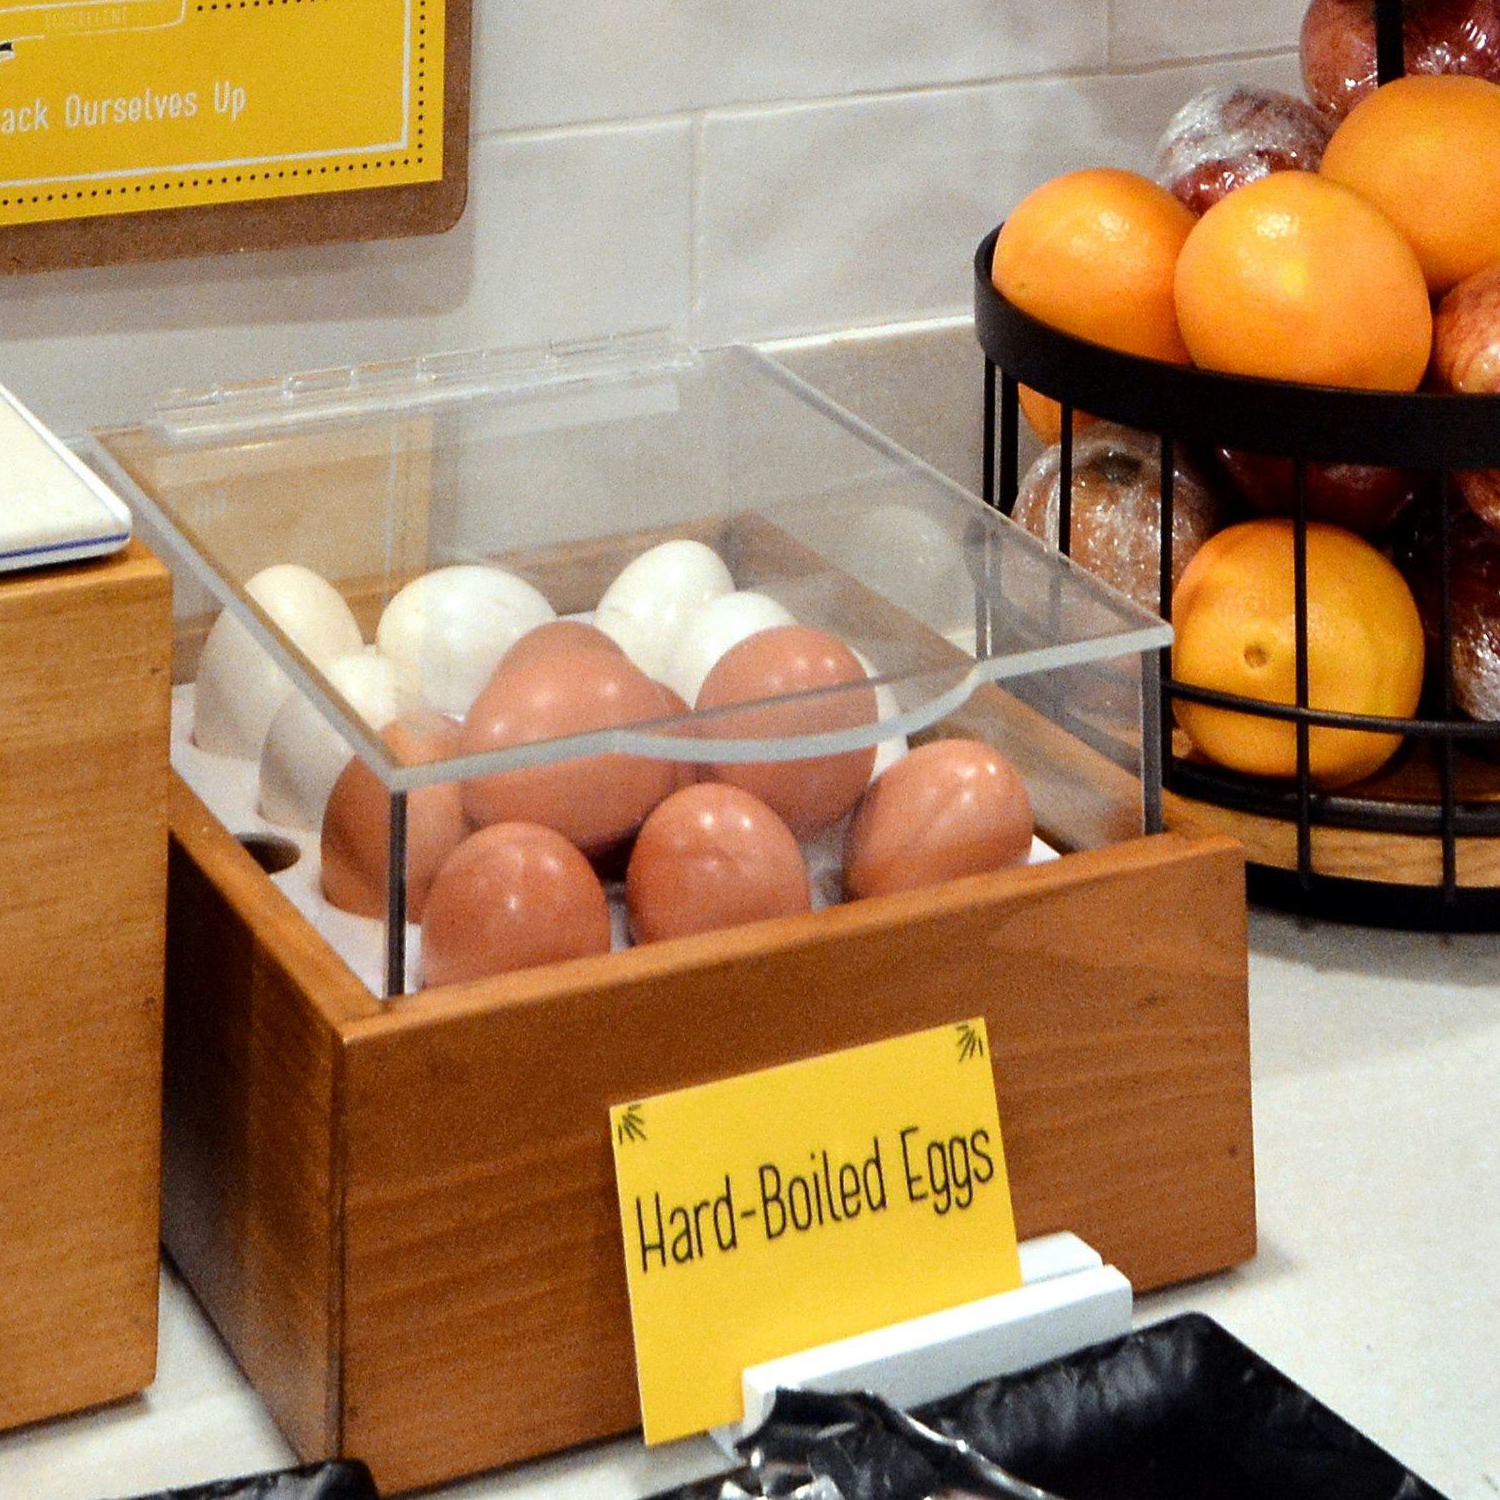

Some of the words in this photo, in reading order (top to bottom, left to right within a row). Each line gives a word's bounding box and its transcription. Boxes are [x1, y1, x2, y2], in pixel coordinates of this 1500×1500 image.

[64, 88, 198, 128] Ourselves
[213, 80, 247, 121] Up
[635, 1138, 888, 1273] Hard-Boiled
[899, 1126, 996, 1216] Eggs
